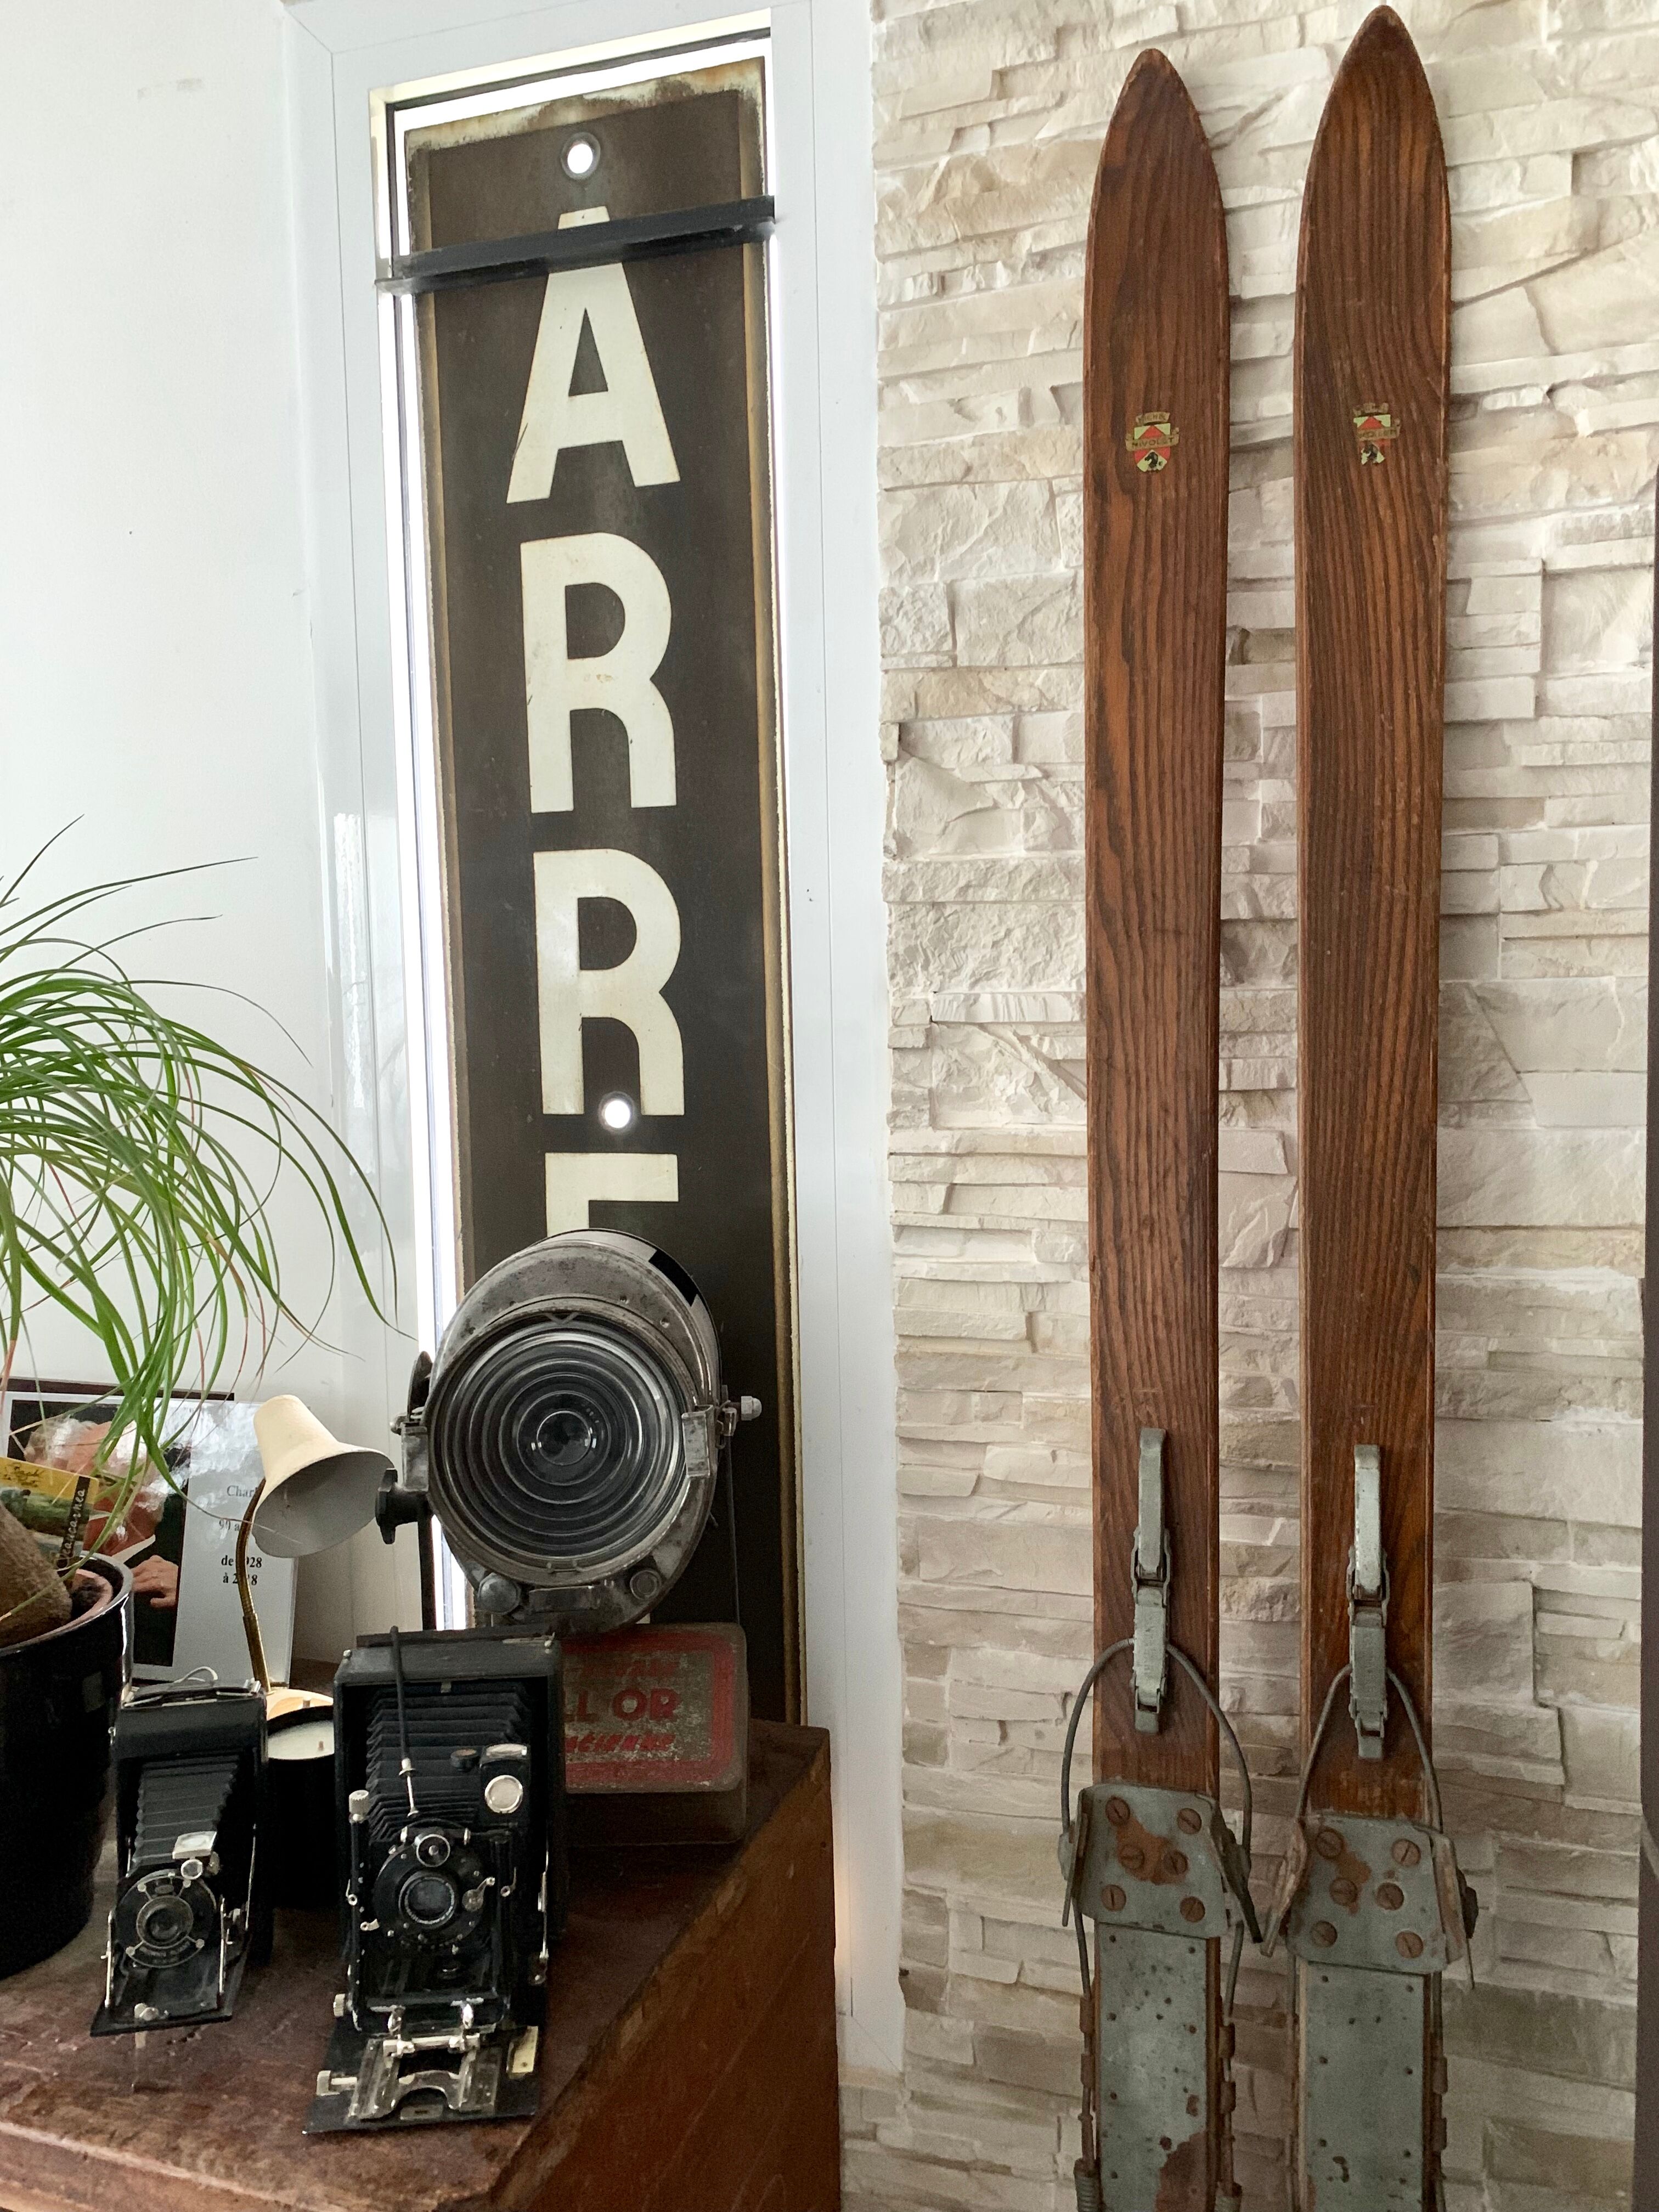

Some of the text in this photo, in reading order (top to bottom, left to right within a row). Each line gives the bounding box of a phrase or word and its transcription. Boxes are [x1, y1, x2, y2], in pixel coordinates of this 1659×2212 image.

[227, 1485, 257, 1497] Char
[221, 1555, 262, 1568] de 28
[222, 1572, 258, 1585] à 28
